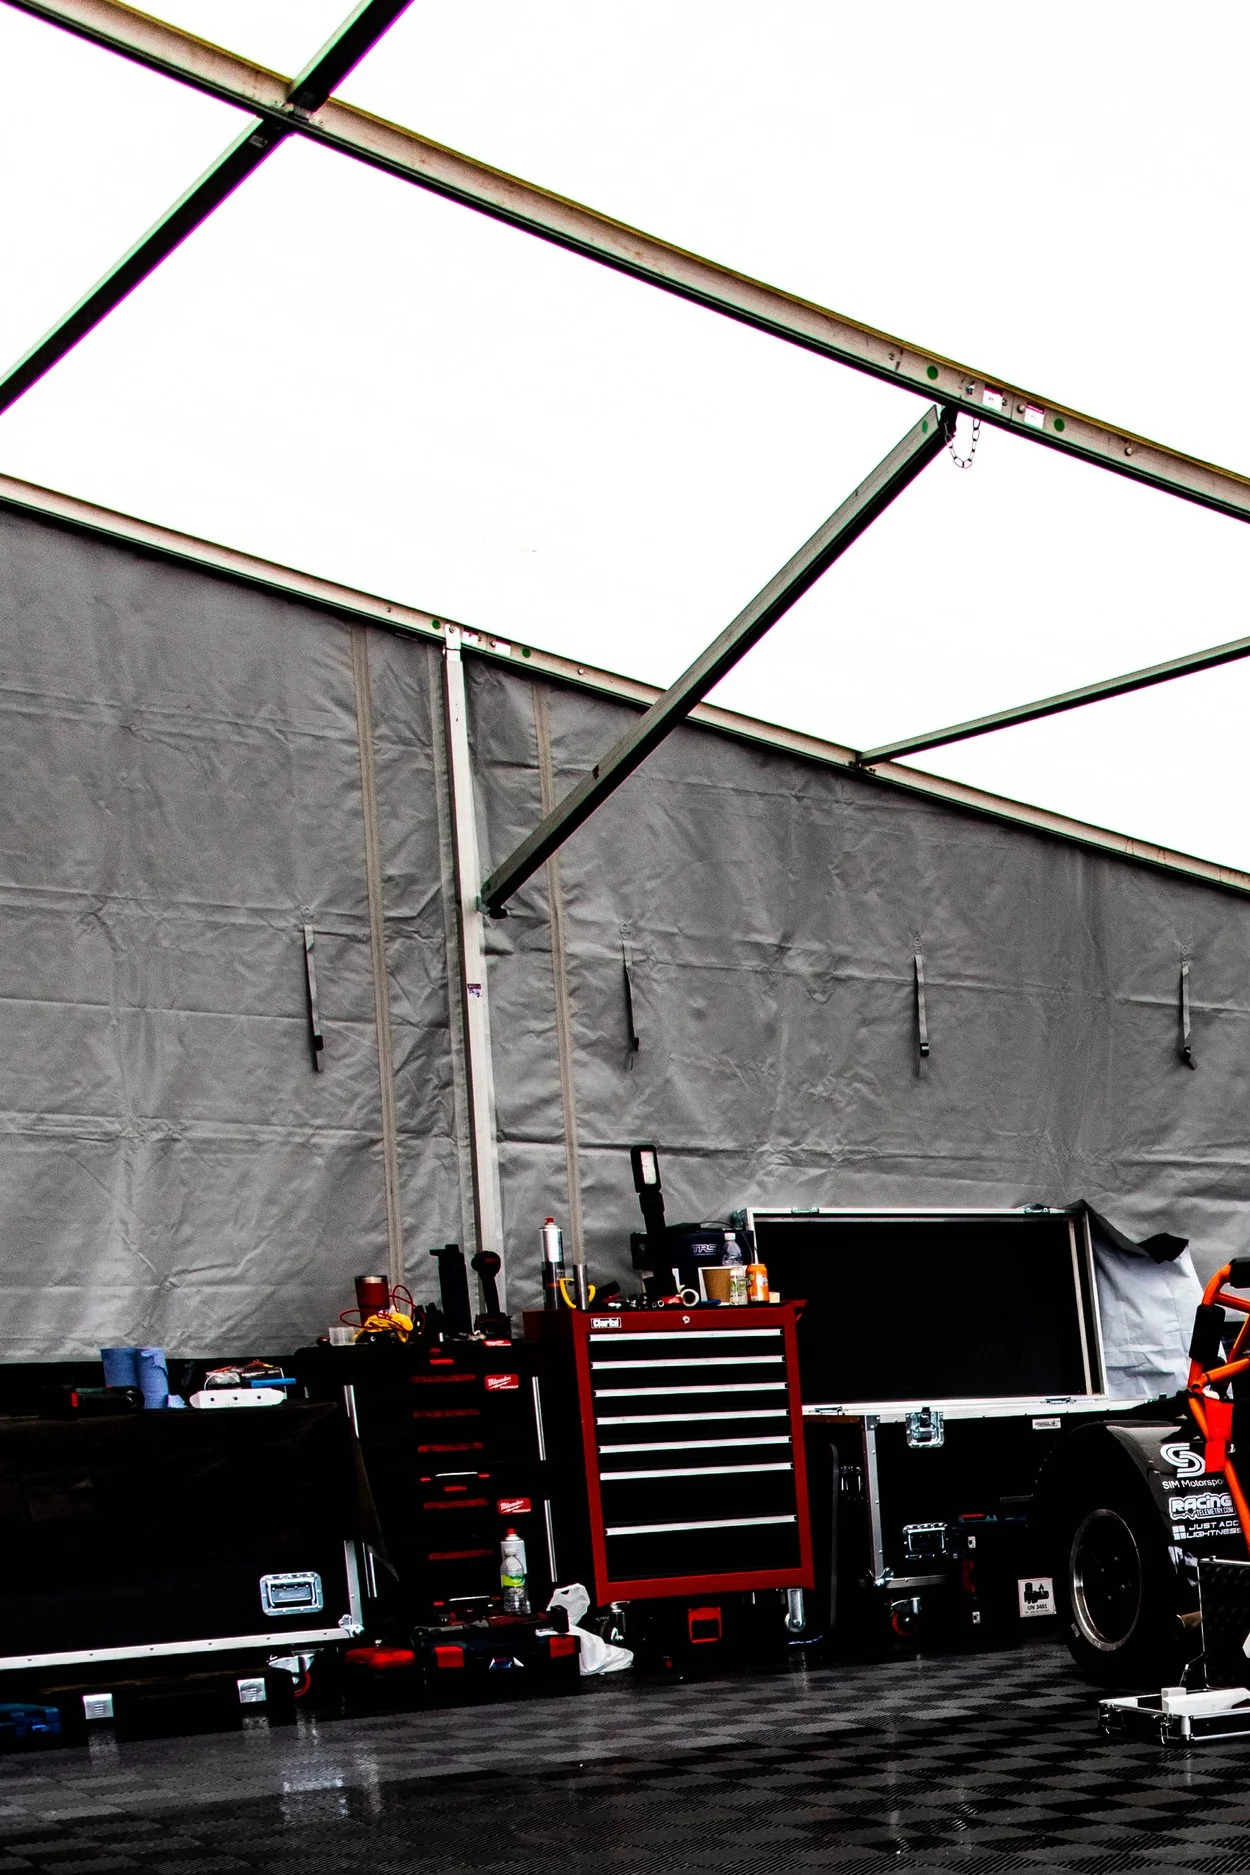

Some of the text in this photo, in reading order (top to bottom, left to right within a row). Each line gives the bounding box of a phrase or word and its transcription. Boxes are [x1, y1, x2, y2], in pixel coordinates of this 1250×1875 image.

[1162, 1478, 1225, 1490] SIM Motorspo
[1188, 1521, 1218, 1531] JUST
[1187, 1528, 1242, 1538] LIGHTNESS
